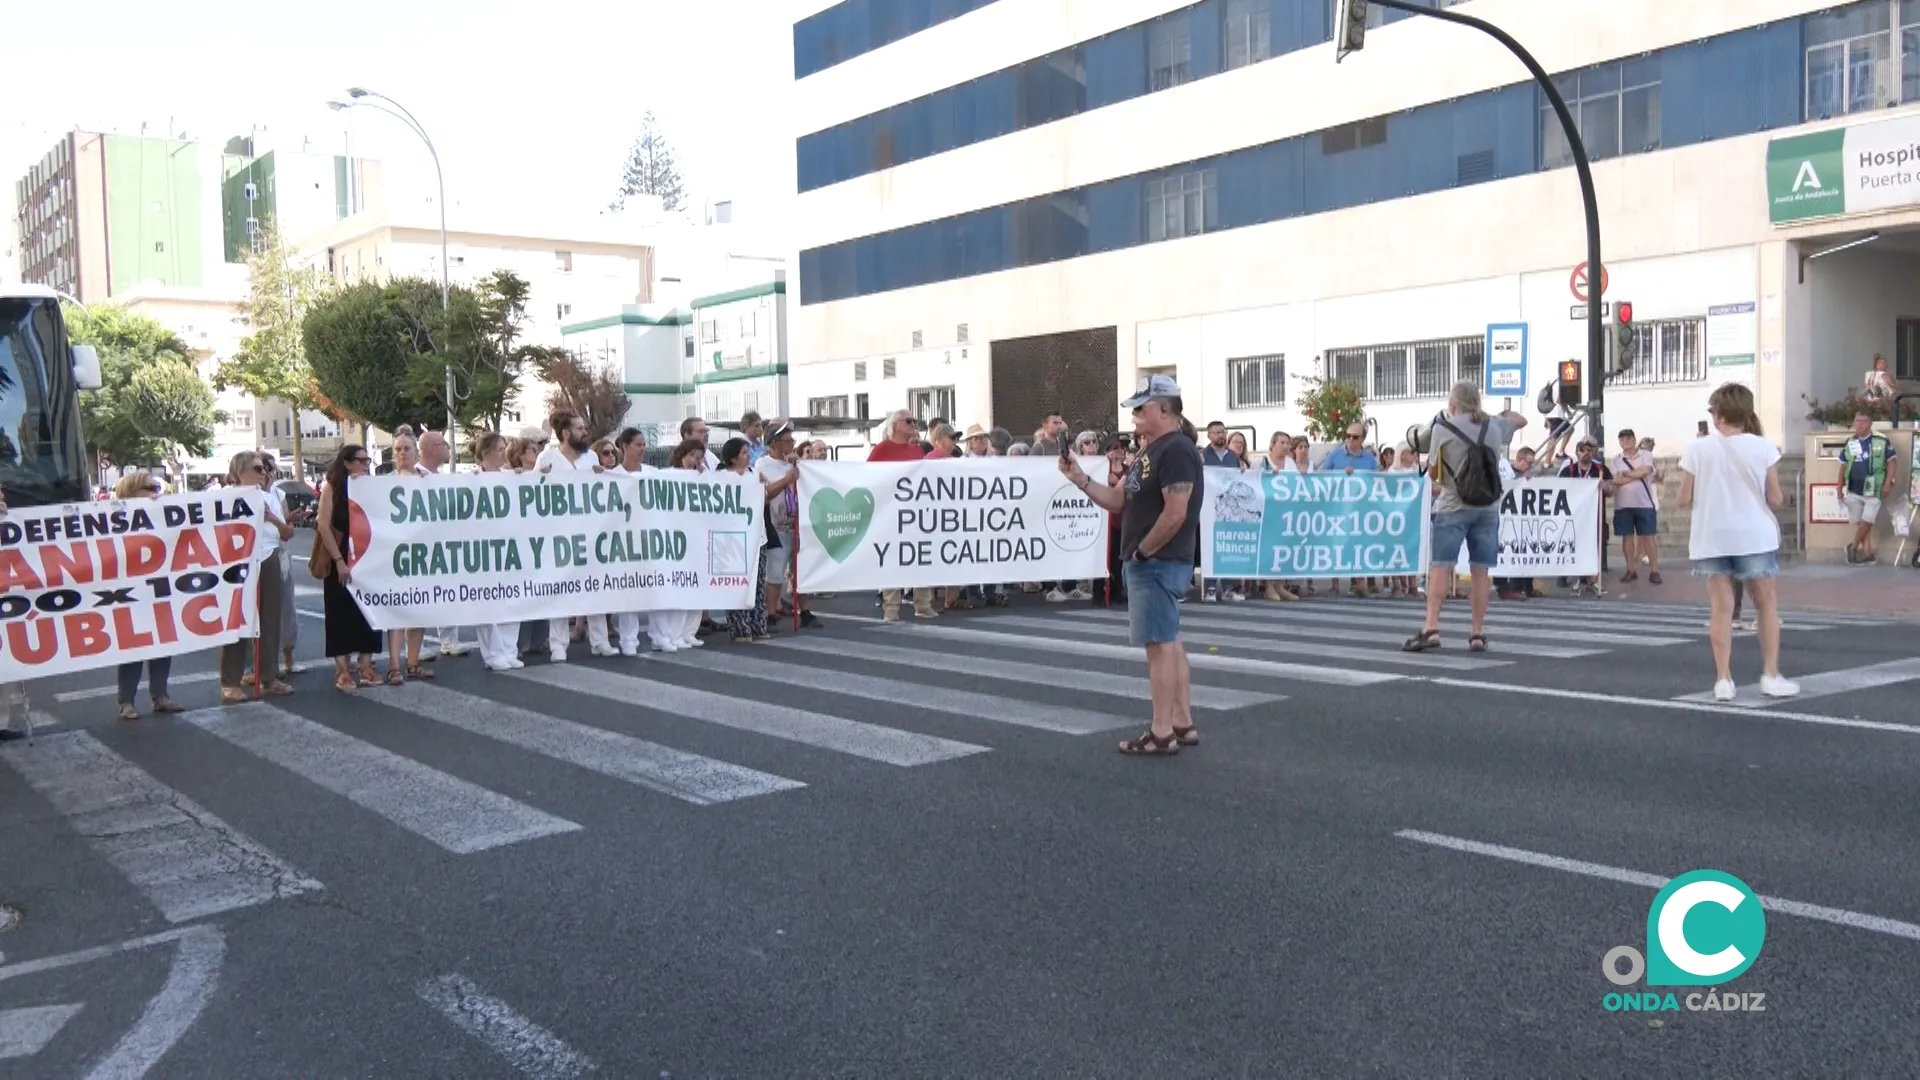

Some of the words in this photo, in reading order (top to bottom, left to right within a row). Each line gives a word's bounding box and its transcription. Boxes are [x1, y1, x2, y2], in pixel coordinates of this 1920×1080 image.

[1861, 172, 1911, 189] Puerta
[390, 484, 510, 524] SANIDAD
[518, 476, 632, 522] PÚBLICA,
[638, 478, 753, 526] UNIVERSAL,
[894, 476, 1028, 502] SANIDAD
[1271, 475, 1420, 502] SANIDAD
[1052, 499, 1094, 509] MAREA
[0, 508, 155, 546] DEFENSA
[163, 502, 204, 528] DE
[214, 497, 254, 522] LA
[898, 507, 1025, 535] PÚBLICA
[1281, 510, 1406, 537] 100x100
[393, 537, 522, 578] GRATUITA
[529, 536, 544, 570] Y
[553, 534, 587, 568] DE
[595, 528, 687, 564] CALIDAD
[874, 543, 891, 567] Y
[899, 541, 932, 566] DE
[940, 537, 1046, 565] CALIDAD
[1271, 538, 1410, 572] PÚBLICA
[433, 584, 456, 604] Pro
[459, 582, 520, 601] Derechos
[523, 571, 581, 597] Humanos
[585, 573, 600, 591] de
[603, 570, 665, 589] Andalucía
[710, 576, 749, 587] APDHA
